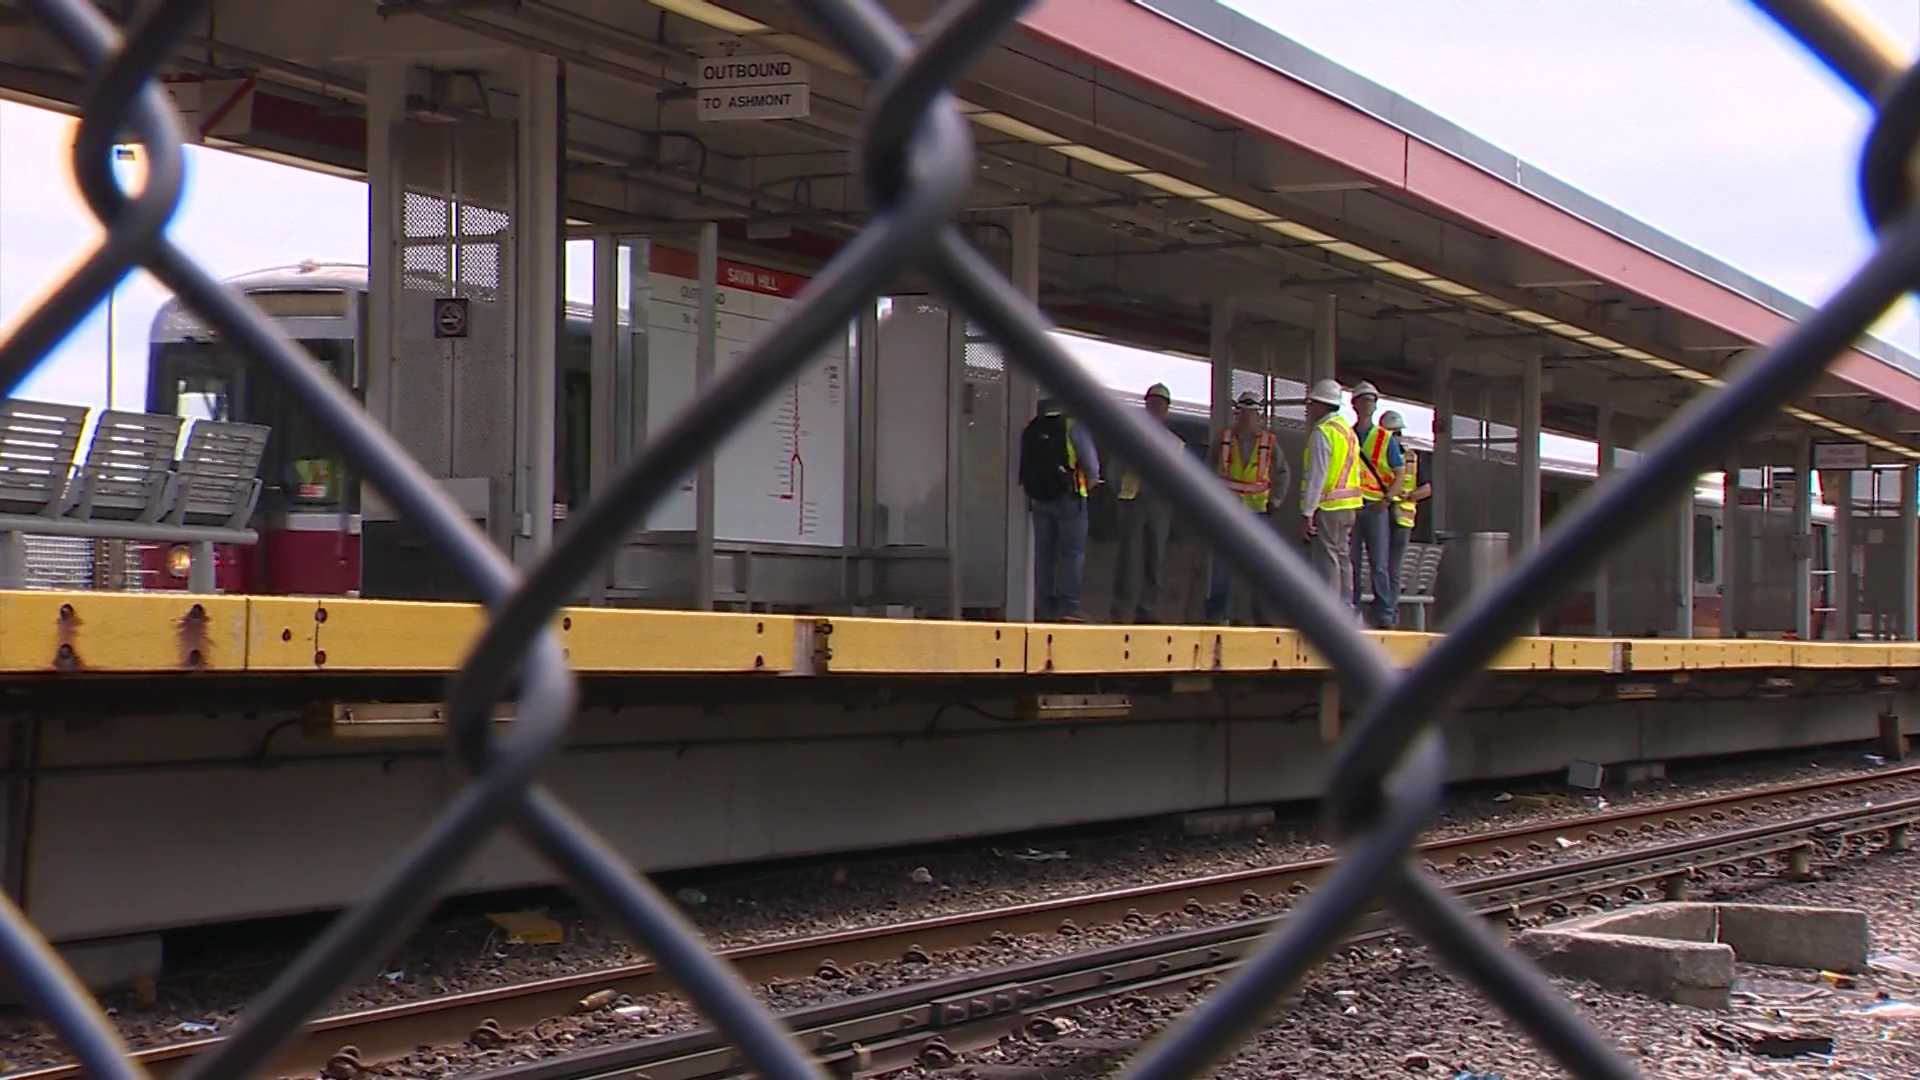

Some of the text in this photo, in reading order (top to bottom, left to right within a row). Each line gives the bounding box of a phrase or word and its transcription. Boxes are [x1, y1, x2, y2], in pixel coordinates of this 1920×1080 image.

[703, 62, 792, 80] OUTBOUND
[703, 94, 792, 109] TO ASHMONT
[757, 273, 779, 292] HILL
